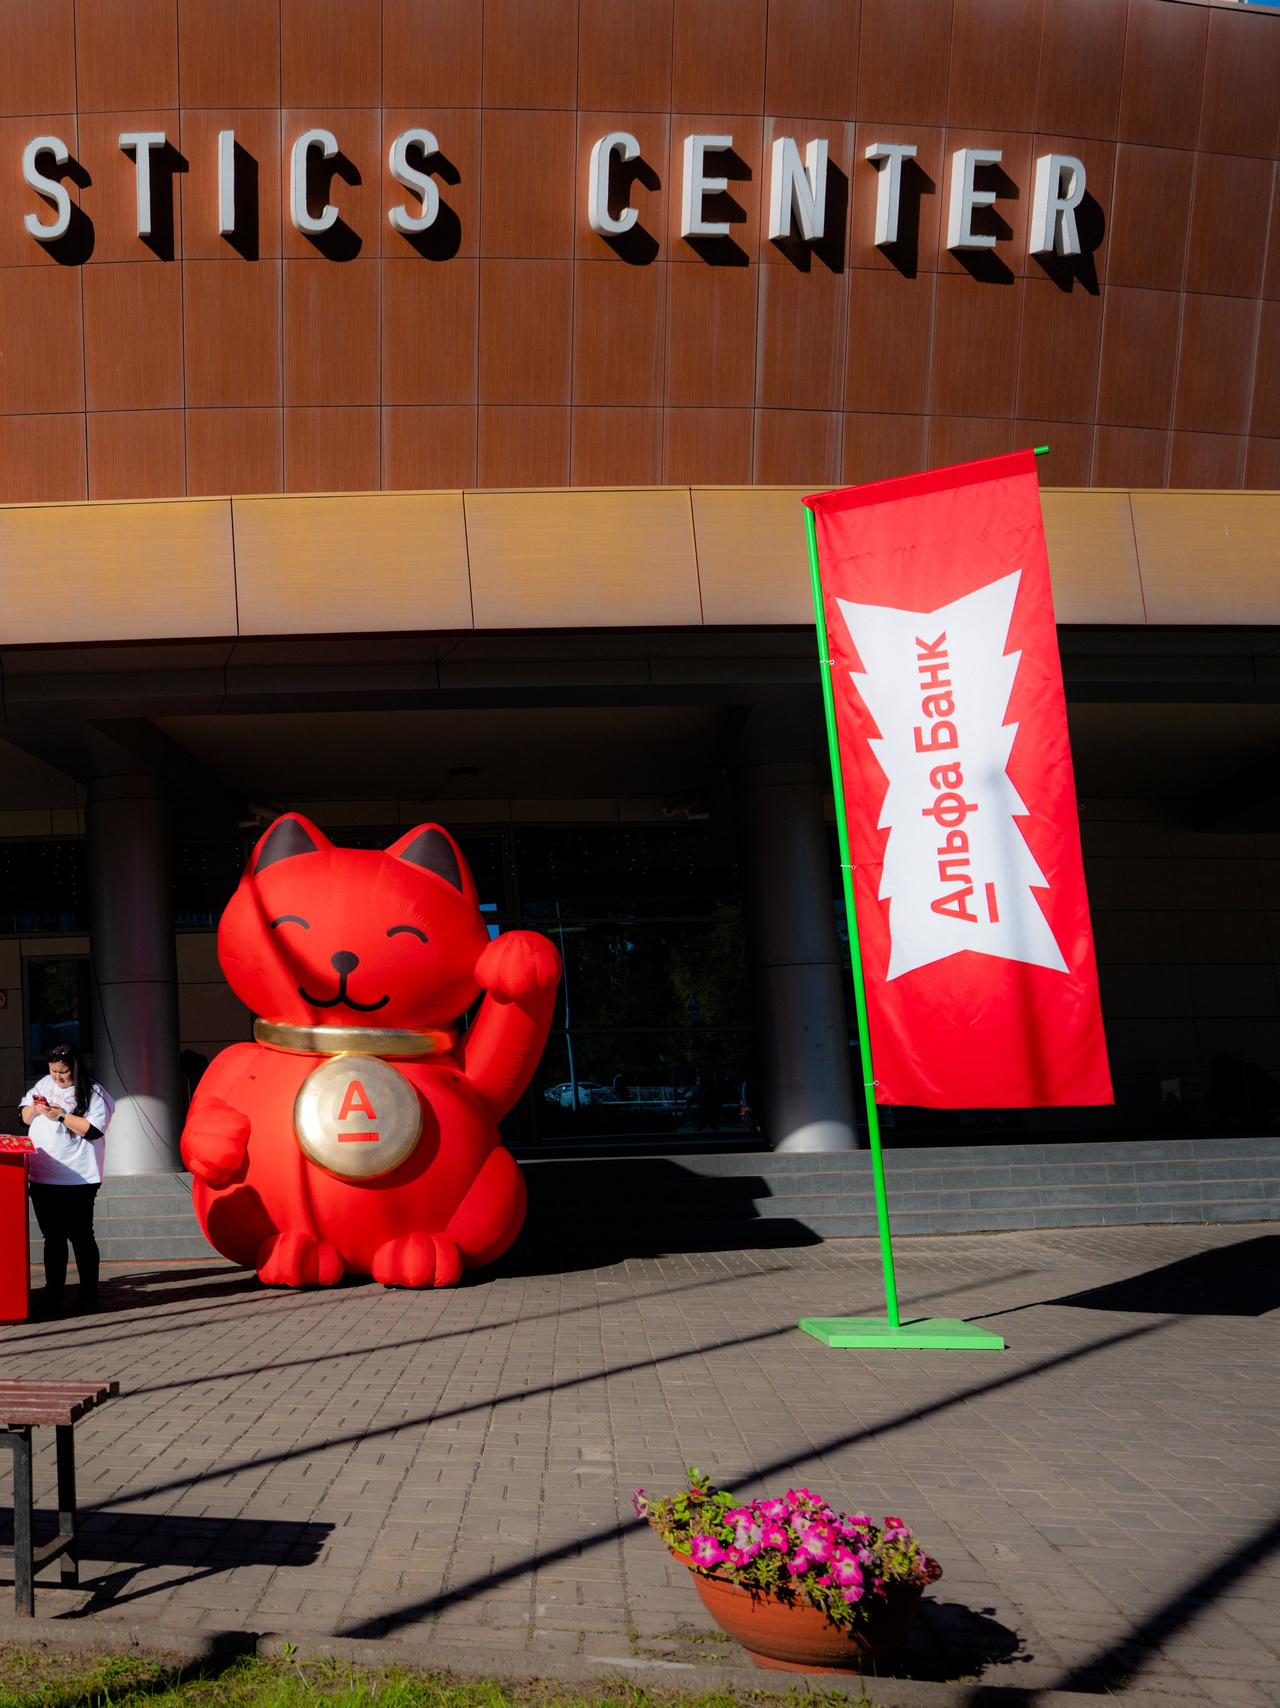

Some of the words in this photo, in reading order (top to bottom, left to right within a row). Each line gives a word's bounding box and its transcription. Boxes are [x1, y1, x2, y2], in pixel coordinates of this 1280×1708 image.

[587, 130, 1087, 257] CENTER
[913, 630, 960, 753] Банк
[922, 761, 979, 924] Альфа
